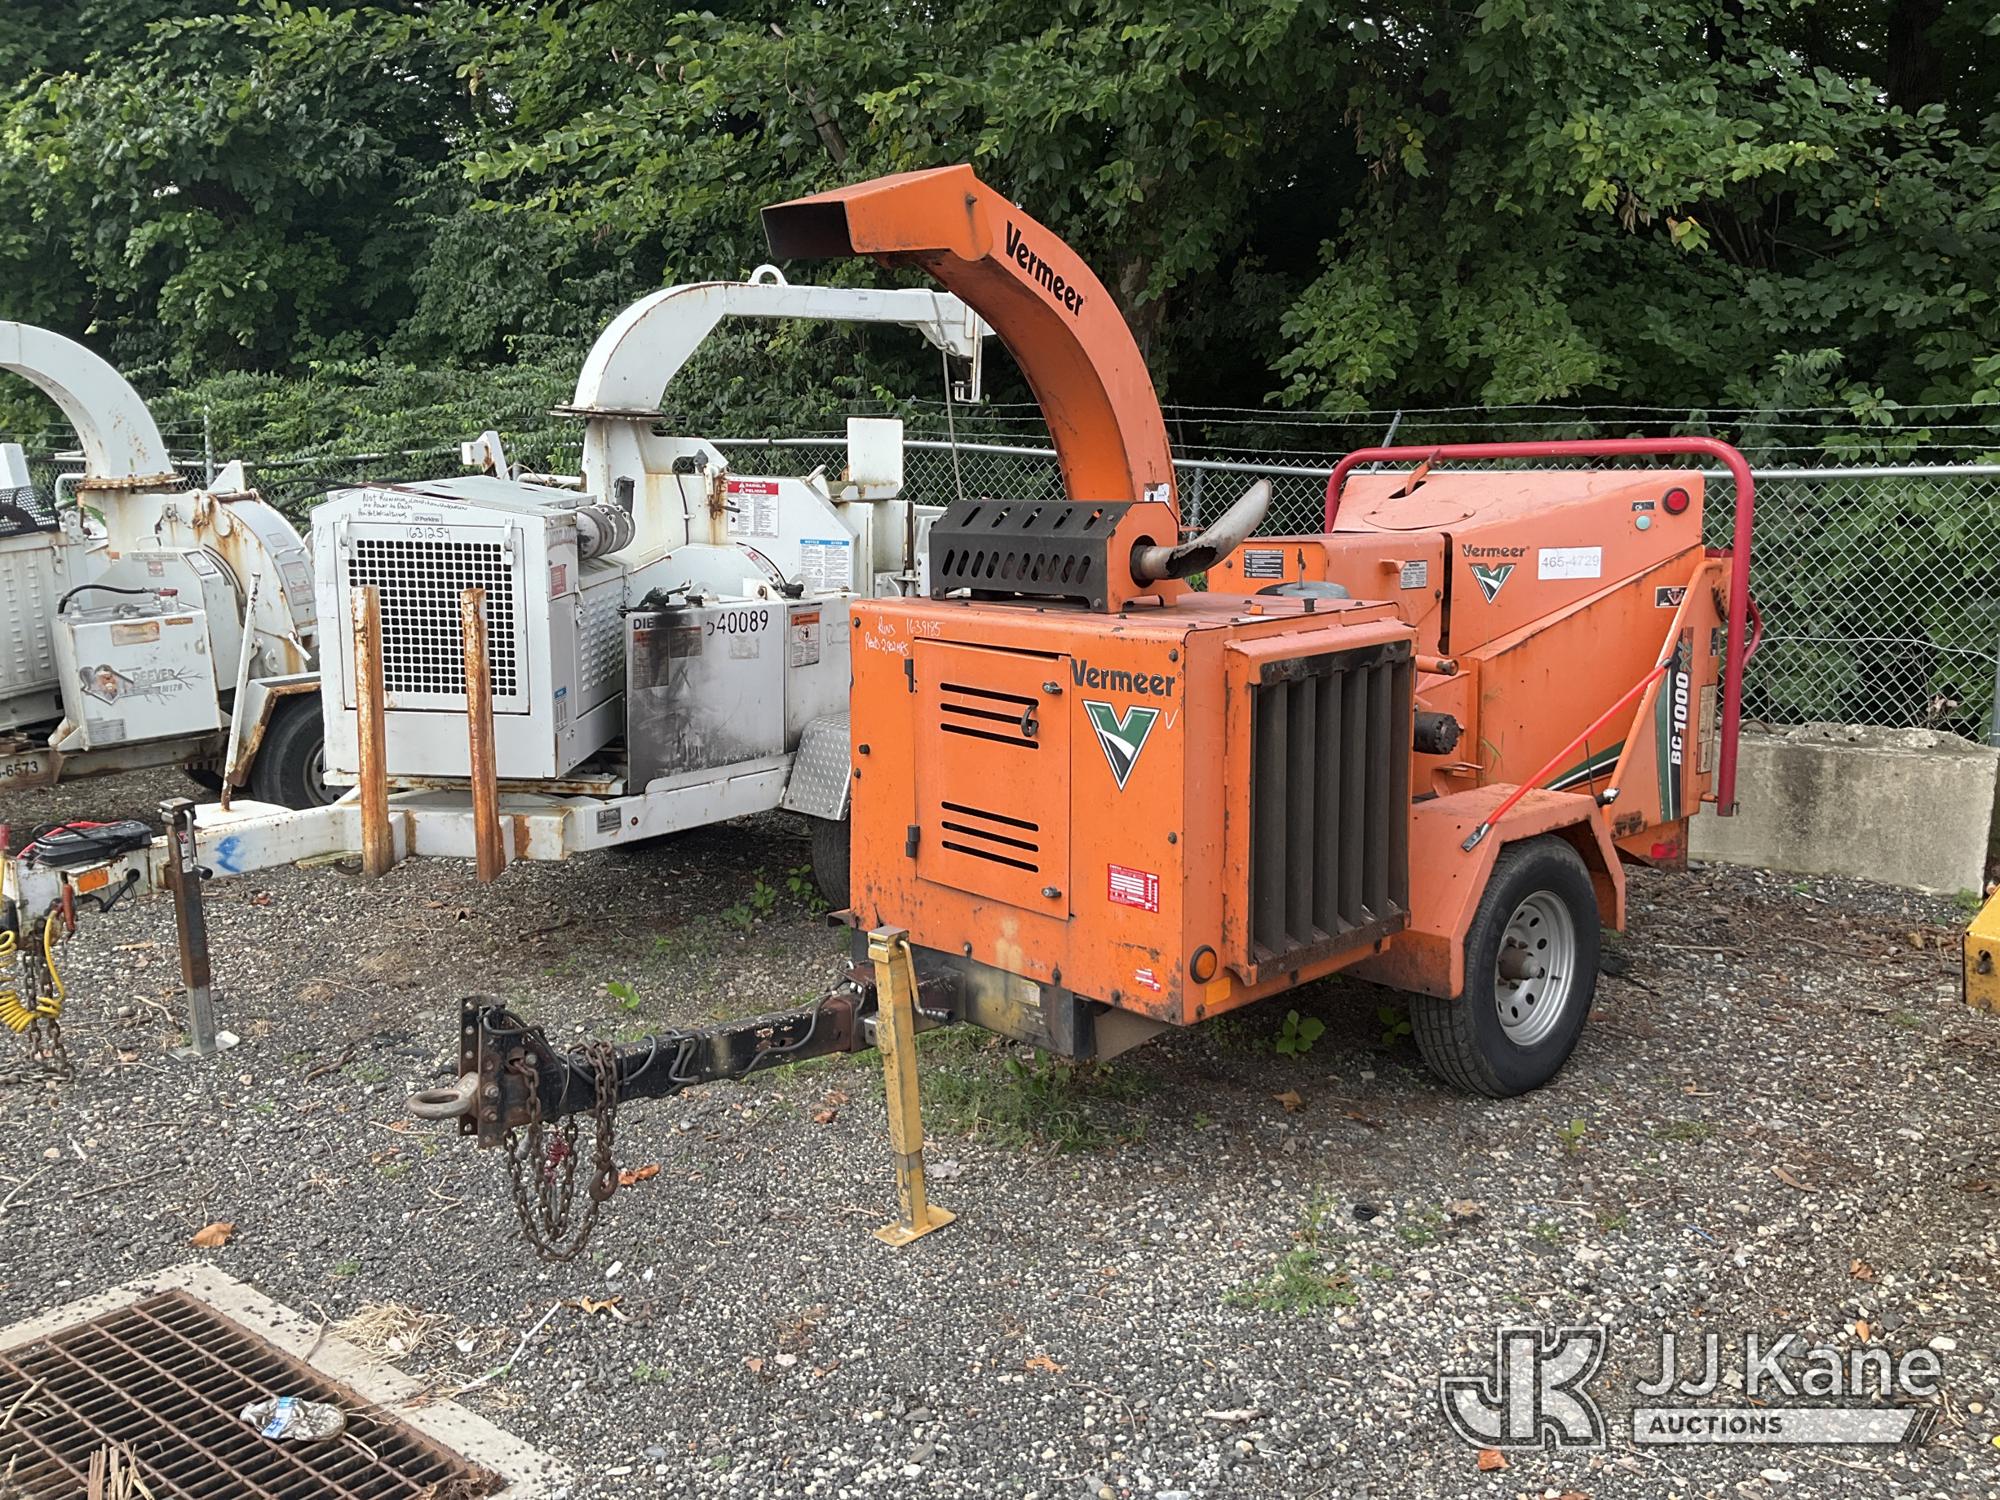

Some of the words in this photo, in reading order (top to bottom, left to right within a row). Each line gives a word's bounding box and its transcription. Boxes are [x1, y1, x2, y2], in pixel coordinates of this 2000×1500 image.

[1006, 219, 1084, 317] Vermeer
[405, 527, 451, 541] 1631254
[1461, 543, 1526, 558] Vermeer
[1541, 554, 1600, 569] 465-4729
[1070, 658, 1176, 697] Vermeer
[0, 760, 39, 779] -6573
